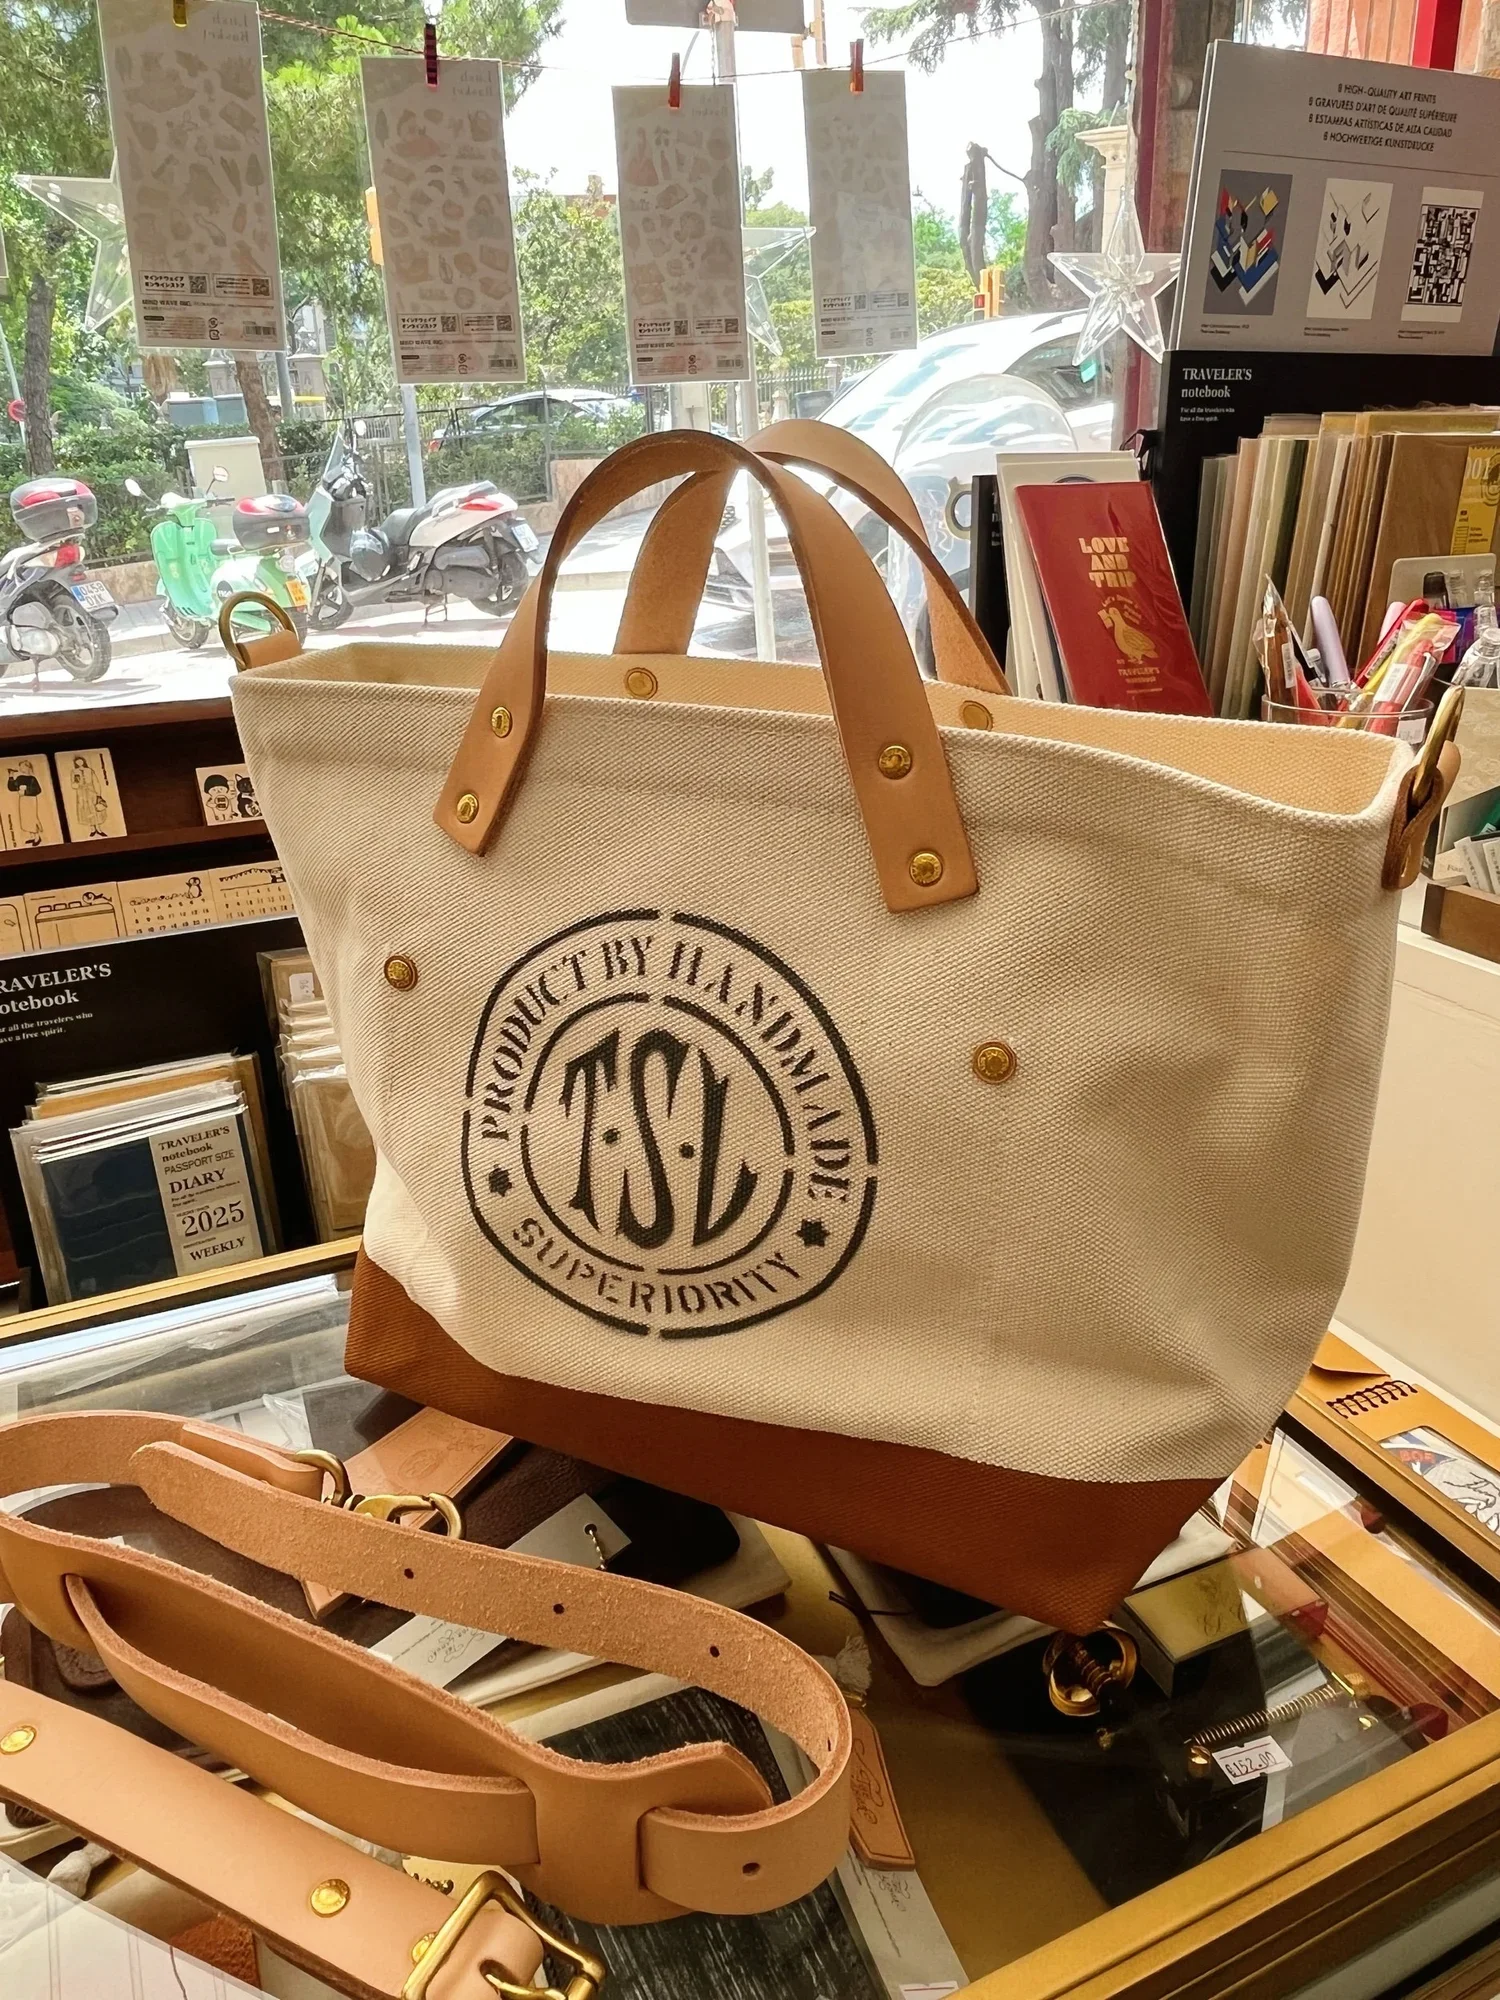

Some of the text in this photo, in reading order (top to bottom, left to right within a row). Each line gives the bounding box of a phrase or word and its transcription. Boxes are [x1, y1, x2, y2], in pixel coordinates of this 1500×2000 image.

[1377, 104, 1387, 115] DE
[1395, 123, 1404, 133] DE
[1182, 368, 1253, 381] TRAVELER'S
[1181, 385, 1231, 398] notebook
[1078, 537, 1130, 554] LOVE
[1091, 554, 1129, 571] AND
[1088, 571, 1137, 588] TRIP
[8, 1023, 19, 1032] all
[21, 1021, 35, 1030] the
[36, 1015, 74, 1027] travelers
[75, 1012, 93, 1020] who
[22, 1031, 39, 1040] free
[482, 935, 852, 1202] PRODUCT BY HANDMADE
[158, 1125, 230, 1151] TRAVELER'S
[162, 1142, 213, 1163] notebook
[164, 1149, 235, 1175] PASSPORT SIZE
[169, 1168, 226, 1194] DIARY
[181, 1200, 245, 1237] 2025
[190, 1237, 246, 1261] WEEKLY
[513, 1217, 801, 1315] SUPERIORITY
